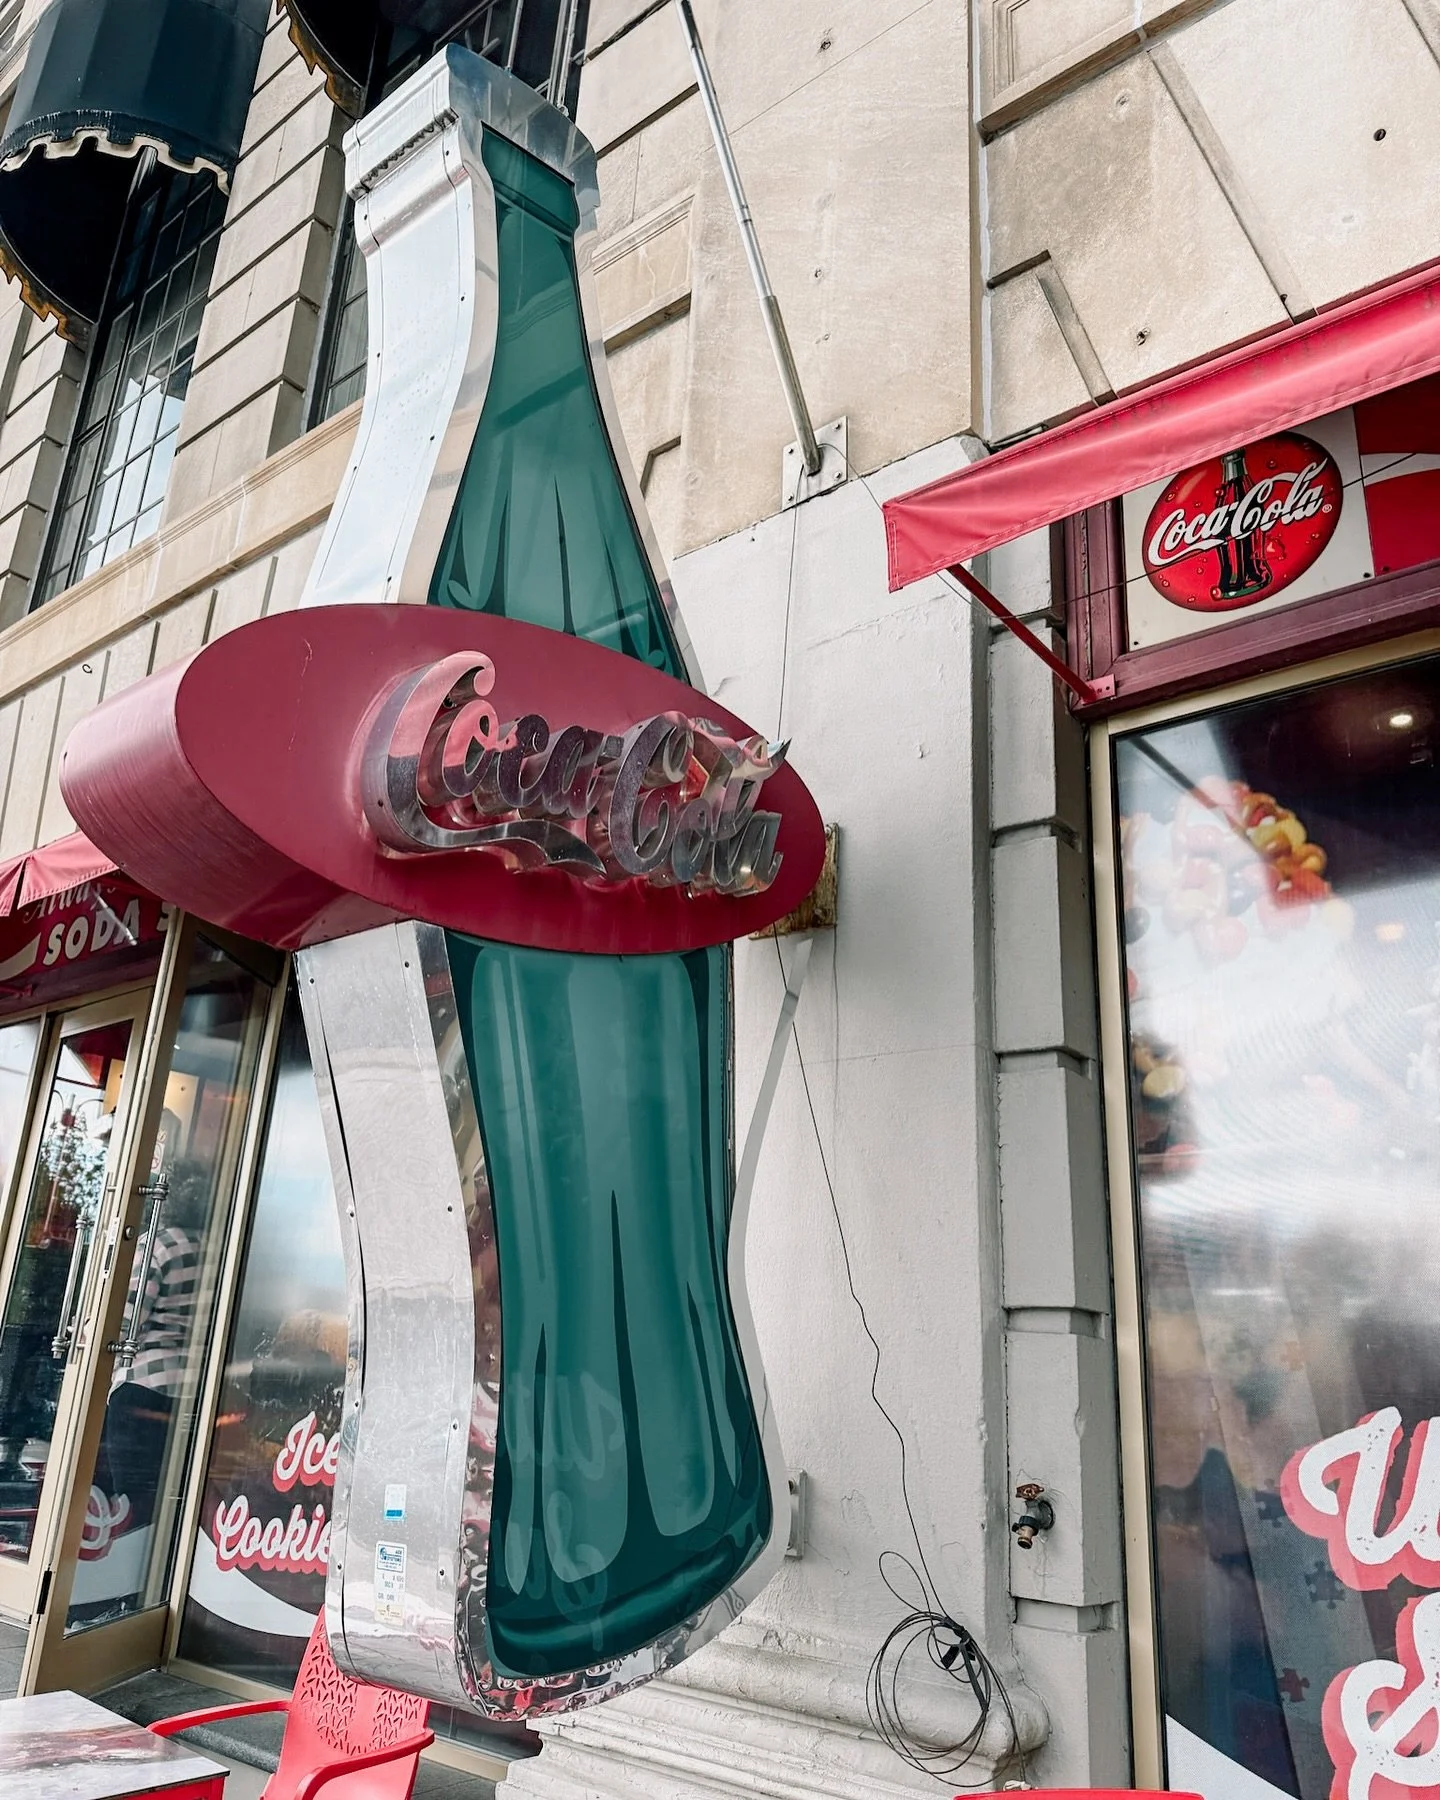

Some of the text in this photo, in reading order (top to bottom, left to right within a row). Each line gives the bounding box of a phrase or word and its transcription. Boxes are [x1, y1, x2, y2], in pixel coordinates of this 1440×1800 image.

[1148, 457, 1328, 567] Coca-Cola
[362, 650, 792, 898] Coca-Cola
[43, 898, 140, 966] SODA
